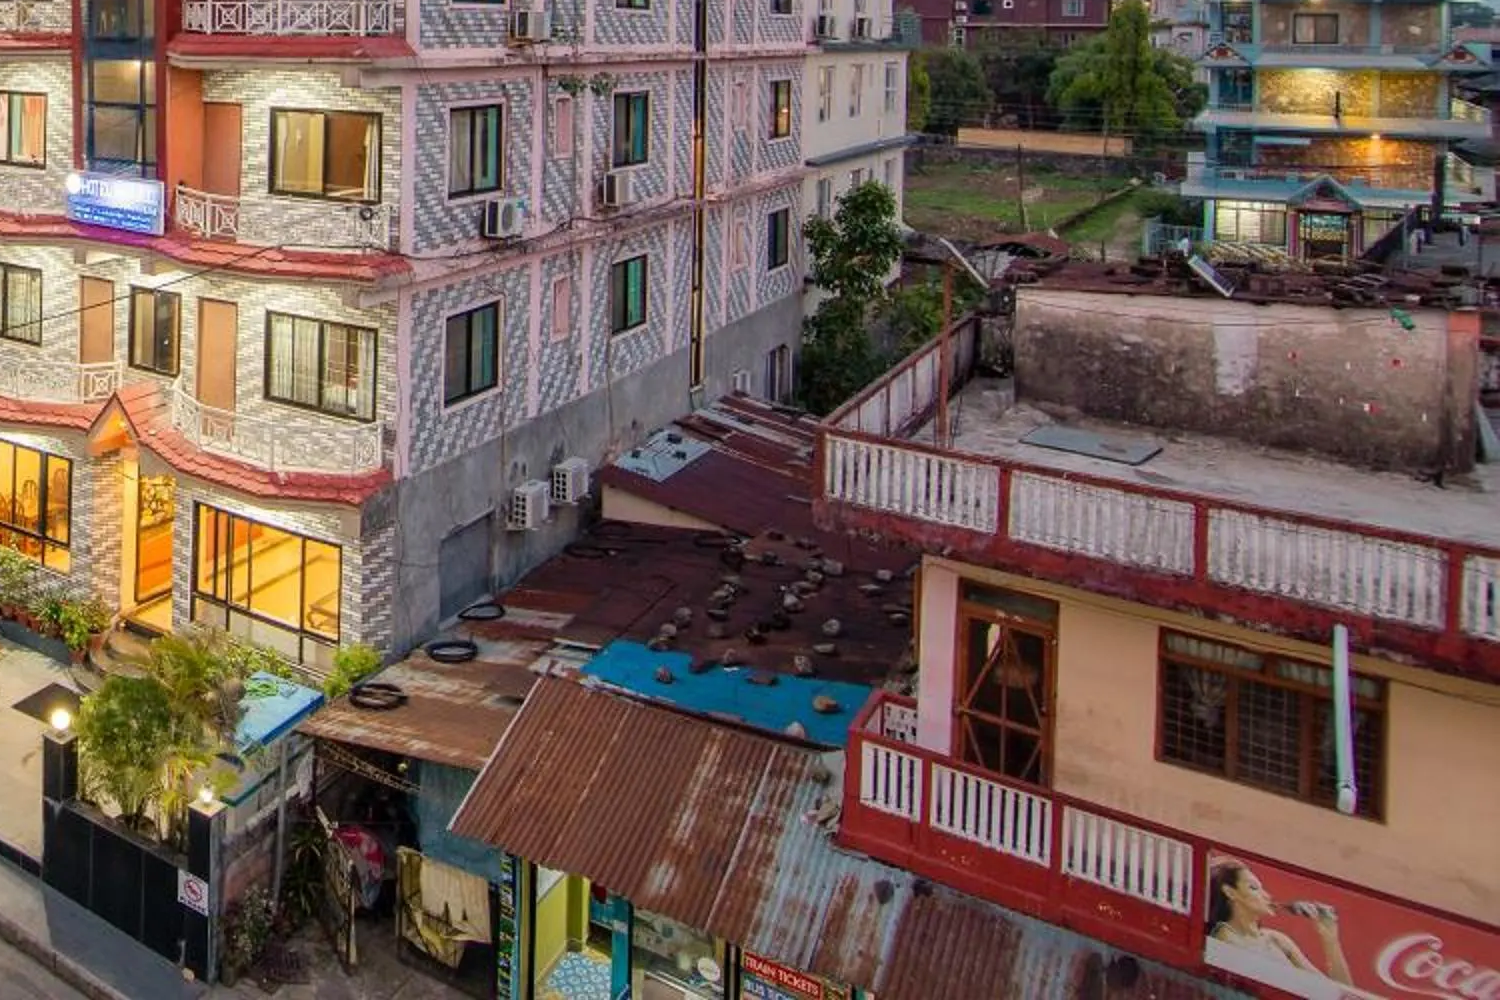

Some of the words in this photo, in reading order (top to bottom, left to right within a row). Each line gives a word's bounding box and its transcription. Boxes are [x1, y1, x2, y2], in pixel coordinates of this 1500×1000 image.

[745, 981, 765, 996] BUS
[746, 957, 777, 976] TRAIN
[779, 970, 818, 994] TICKETS
